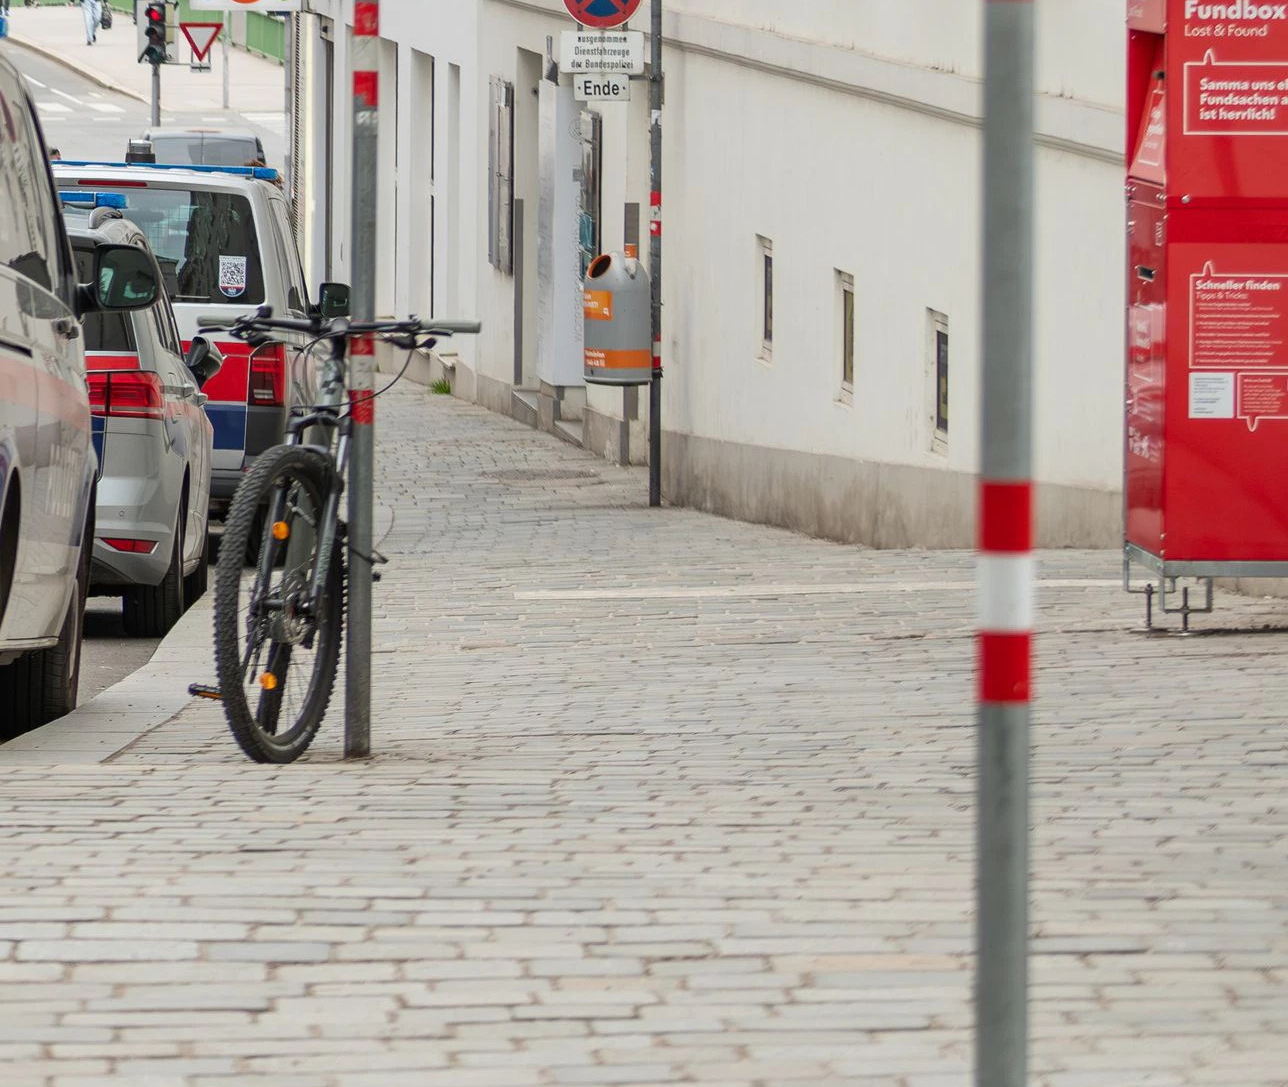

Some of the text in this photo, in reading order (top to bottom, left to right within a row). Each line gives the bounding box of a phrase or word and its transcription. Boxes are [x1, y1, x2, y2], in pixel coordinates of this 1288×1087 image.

[1184, 24, 1268, 37] Lost & Found
[577, 35, 627, 45] ausgenommen
[575, 46, 630, 57] Dienstfahrzeuge
[585, 59, 633, 70] Bundespolizei
[584, 80, 620, 96] Ende
[1200, 78, 1248, 91] Samma
[1251, 80, 1274, 91] uns
[1200, 93, 1279, 106] Fundsachen
[1200, 107, 1276, 120] ist herrlich!
[1196, 280, 1280, 290] Schneller finden
